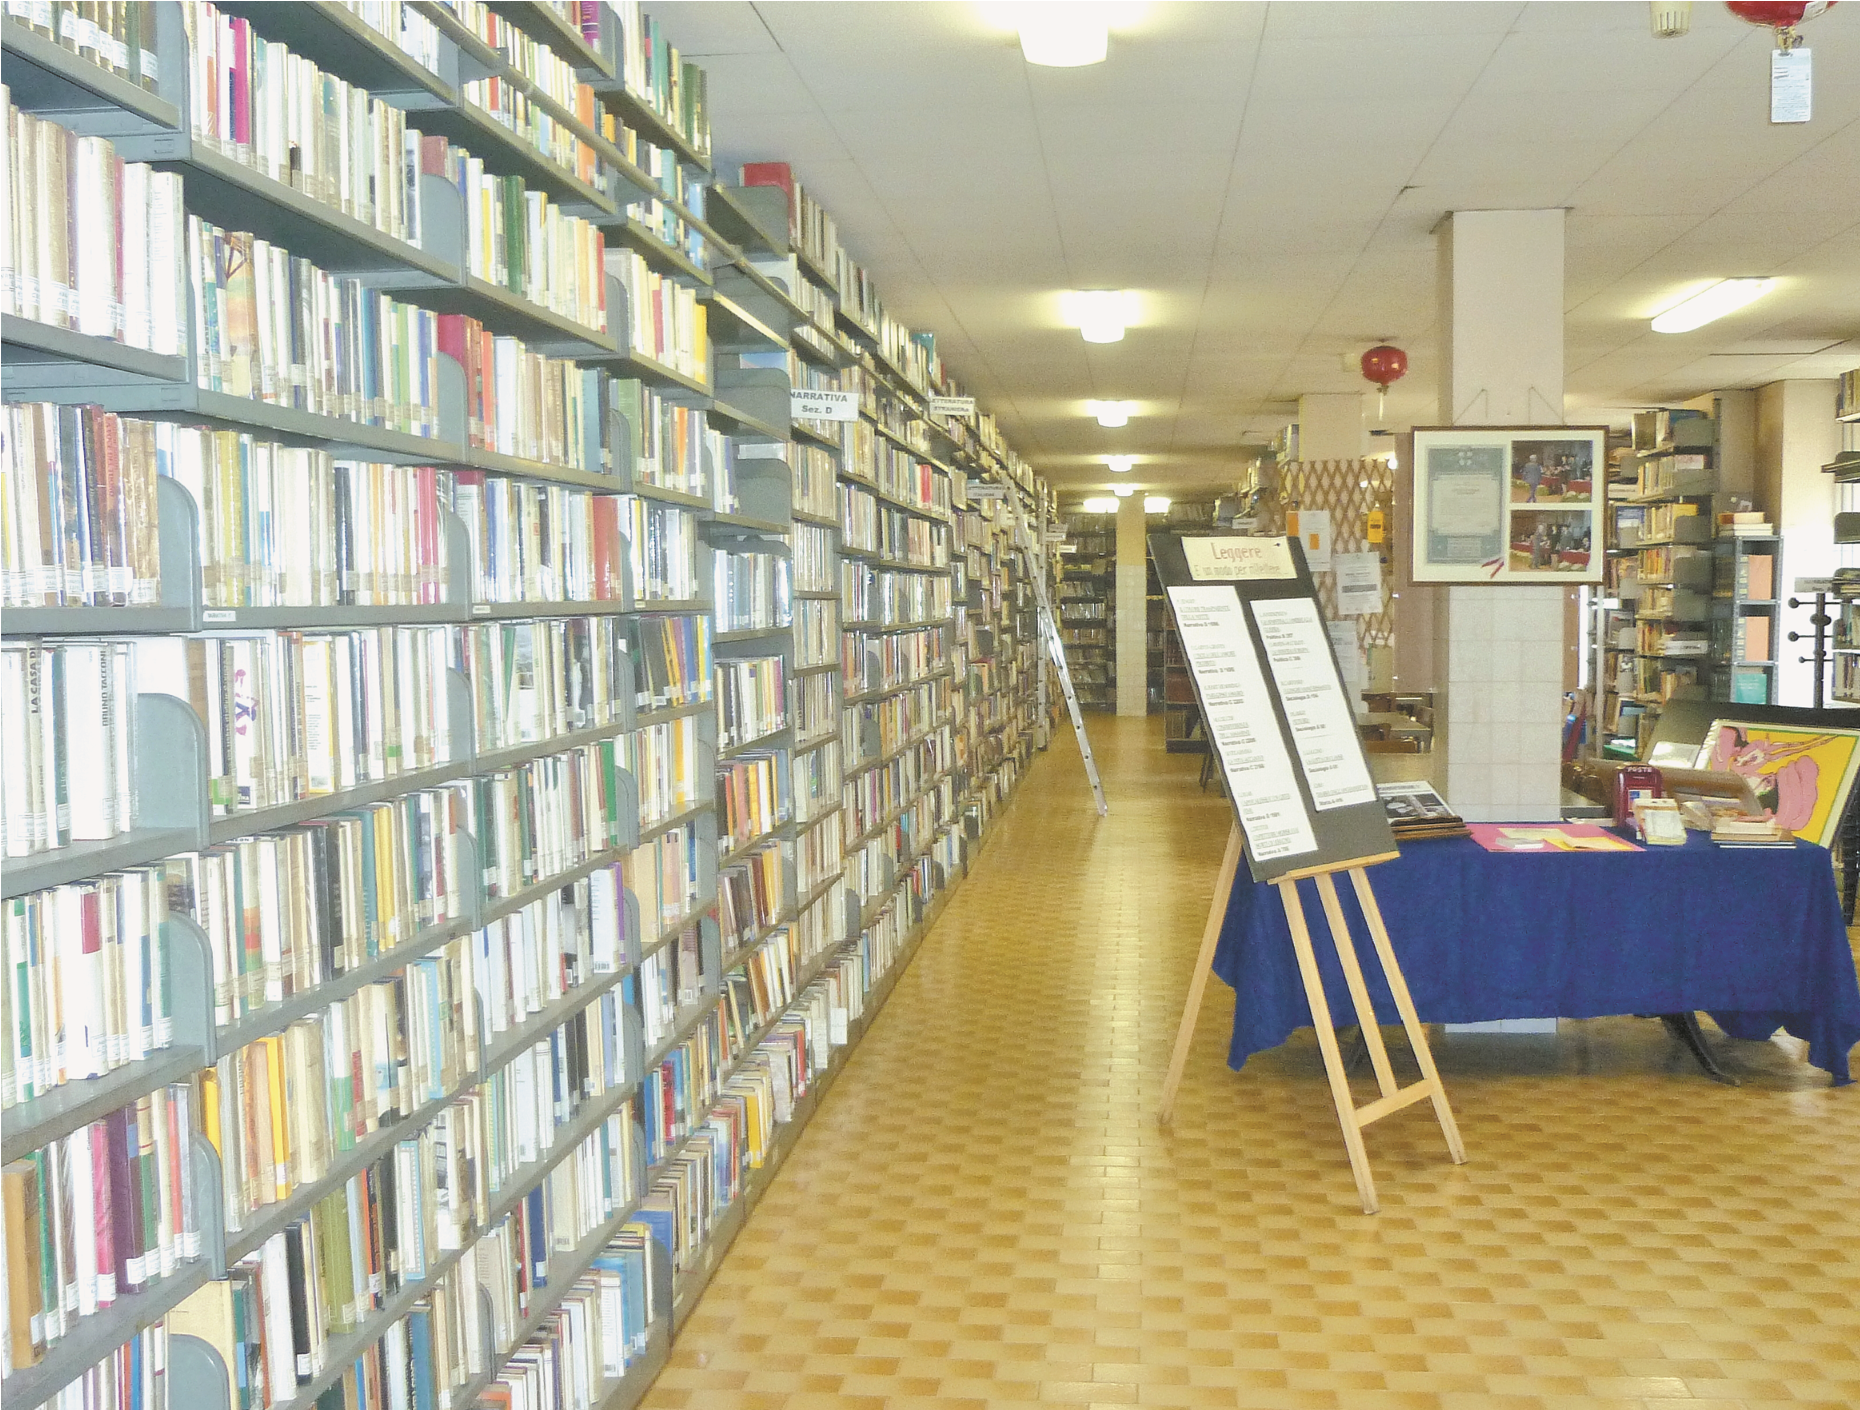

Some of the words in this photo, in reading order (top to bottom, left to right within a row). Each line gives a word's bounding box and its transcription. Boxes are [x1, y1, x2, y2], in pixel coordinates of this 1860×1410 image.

[790, 391, 848, 403] NARRATIVA
[801, 404, 822, 414] Sez.
[825, 406, 833, 414] D
[1211, 542, 1262, 562] Leggere
[1234, 565, 1247, 576] per
[29, 646, 37, 659] DI
[100, 650, 108, 690] TACCONI
[30, 665, 38, 695] CASA
[31, 698, 39, 714] LA
[101, 693, 109, 727] BRUNO
